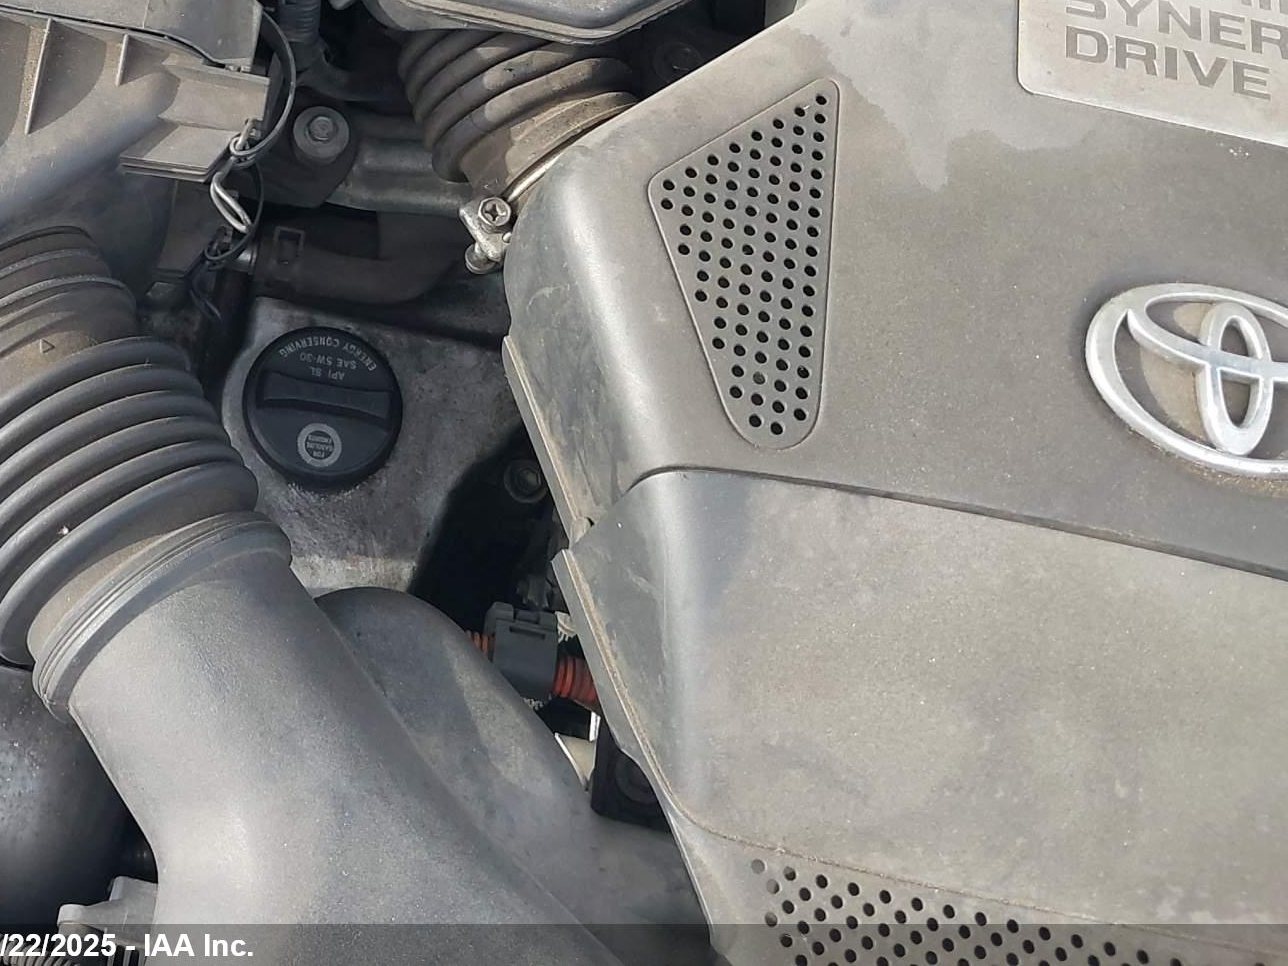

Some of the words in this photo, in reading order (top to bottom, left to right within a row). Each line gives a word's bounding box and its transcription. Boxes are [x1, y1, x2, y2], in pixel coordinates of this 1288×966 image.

[1065, 25, 1272, 100] DRIVE
[278, 335, 341, 358] CONSERVING
[299, 352, 333, 366] 5W-30
[335, 357, 358, 370] SAE
[341, 341, 378, 371] ENERGY
[327, 369, 346, 381] API
